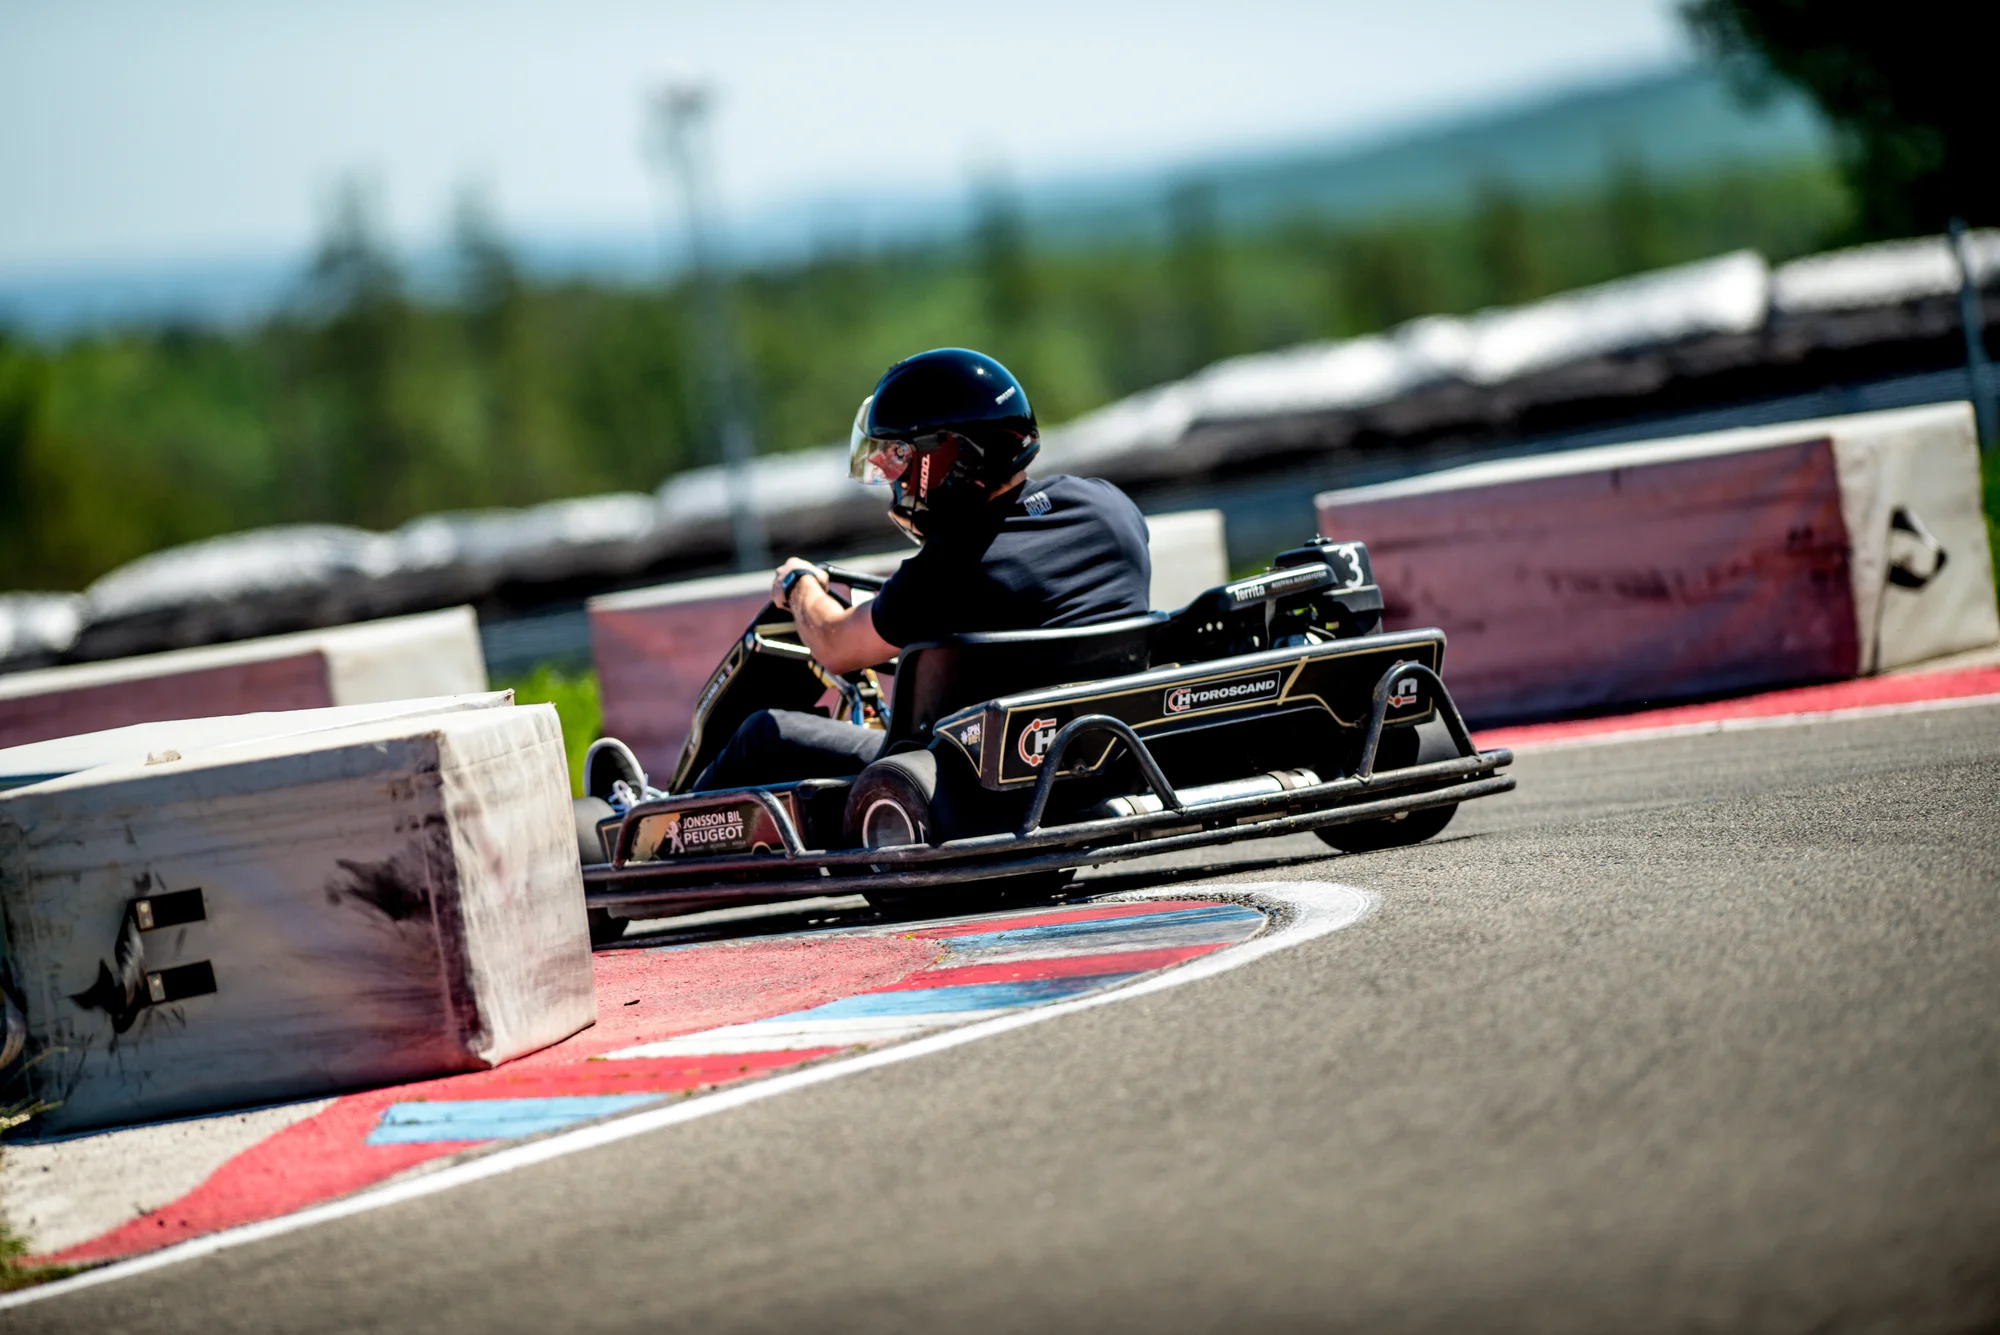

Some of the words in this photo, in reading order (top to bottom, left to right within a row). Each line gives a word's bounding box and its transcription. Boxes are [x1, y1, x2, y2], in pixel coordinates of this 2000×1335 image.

[1338, 545, 1364, 589] 3
[1235, 584, 1266, 602] Territa
[1177, 679, 1276, 706] HYDROSCAND
[683, 813, 726, 829] JONSSON
[727, 810, 743, 822] BIL
[684, 825, 744, 845] PEUGEOT
